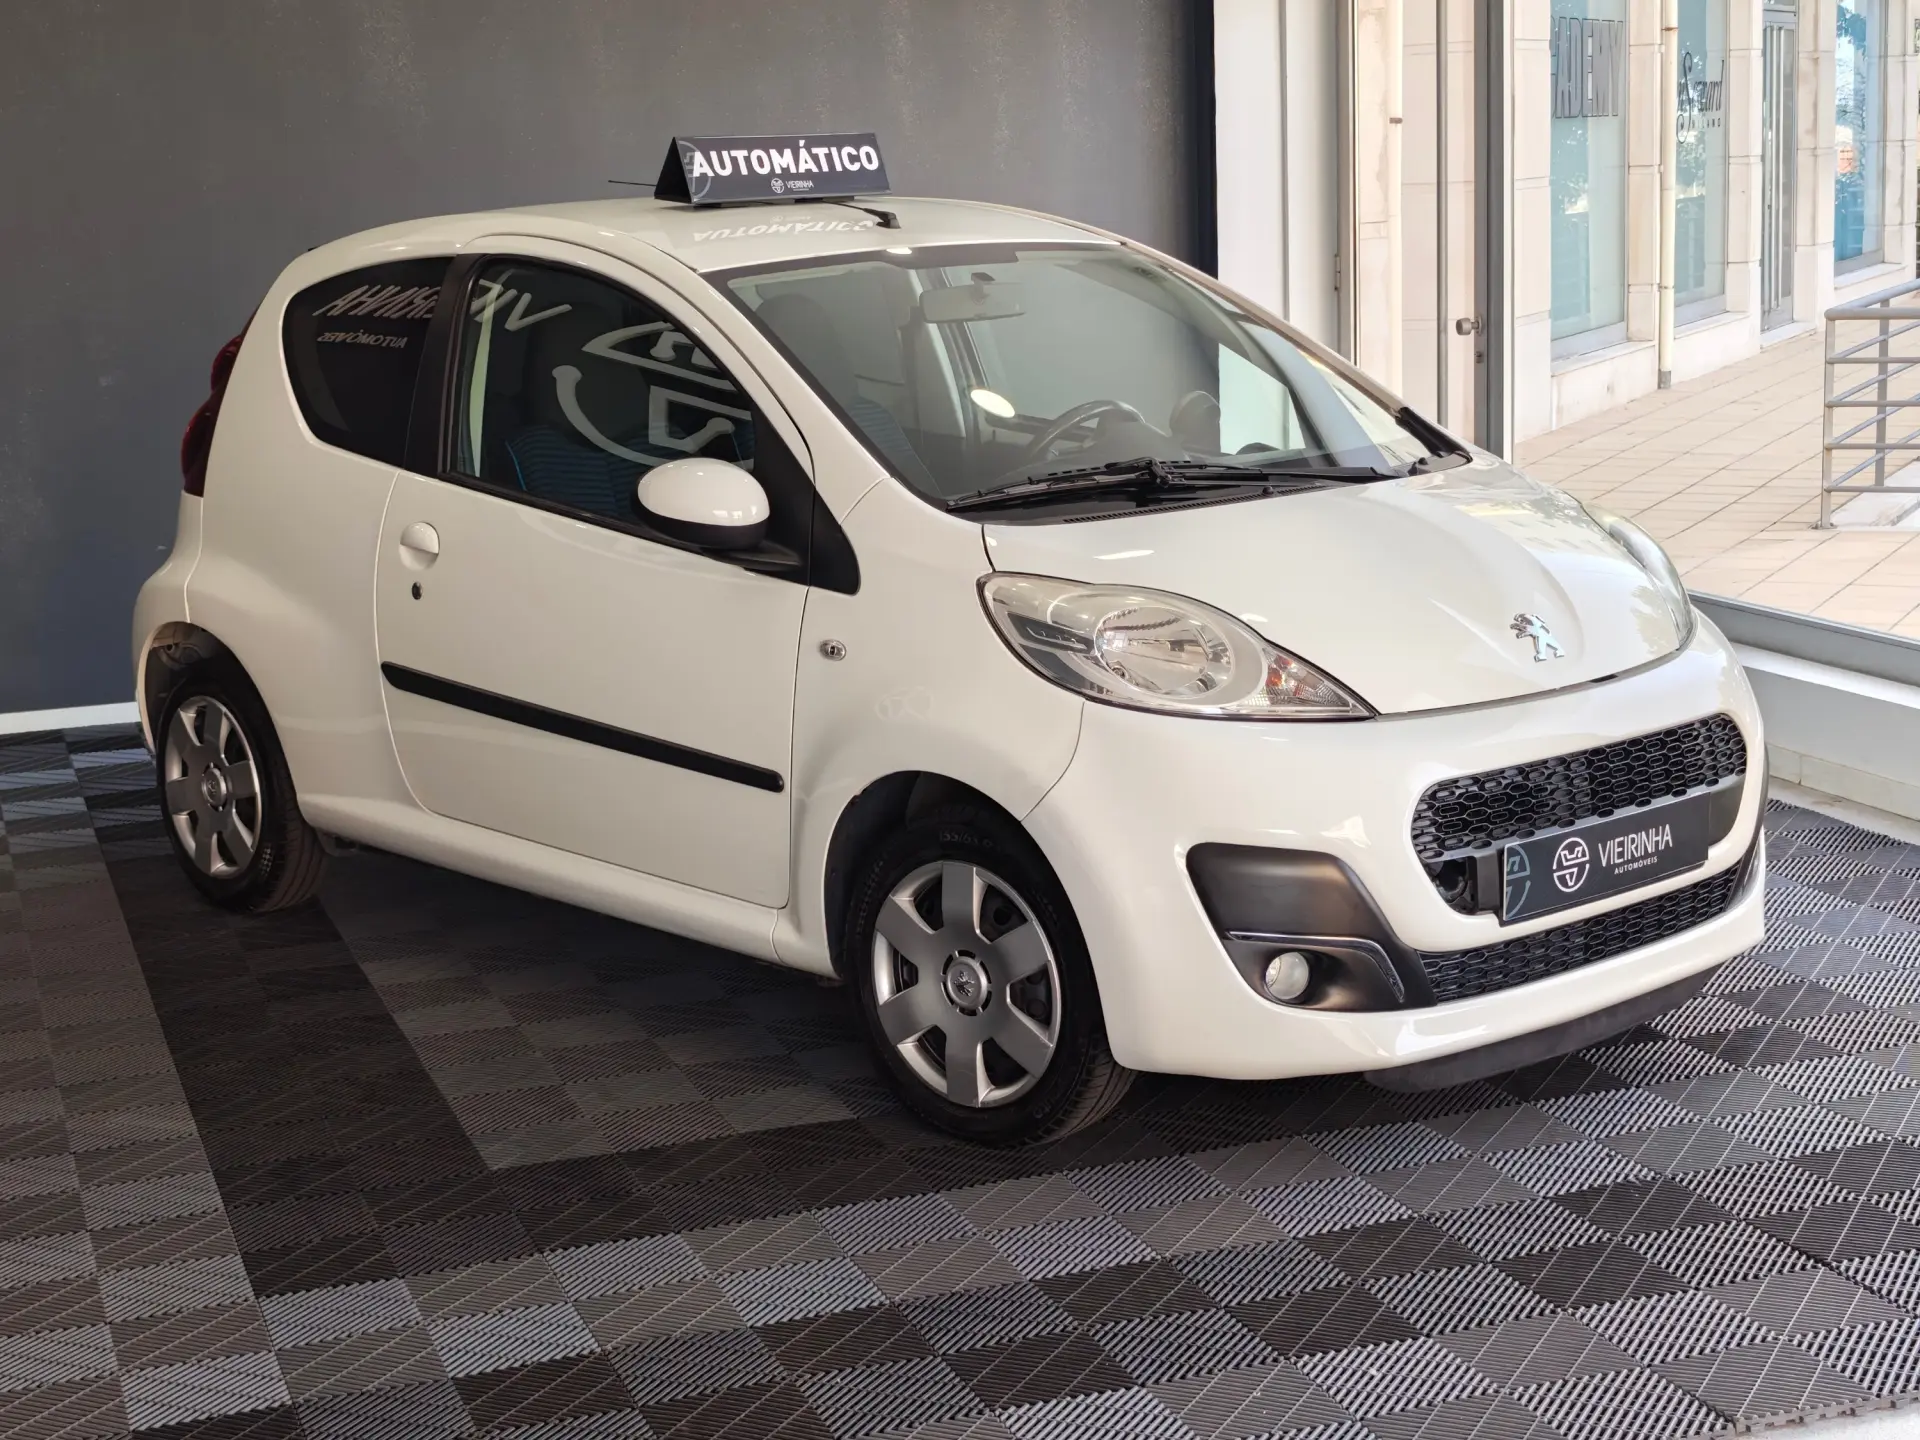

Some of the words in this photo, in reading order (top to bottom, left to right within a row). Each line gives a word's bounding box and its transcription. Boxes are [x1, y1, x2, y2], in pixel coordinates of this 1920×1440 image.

[692, 140, 879, 178] AUTOMÁTICO
[1598, 824, 1673, 867] VIEIRINHA
[1614, 855, 1658, 875] AUTOMÓVEIS
